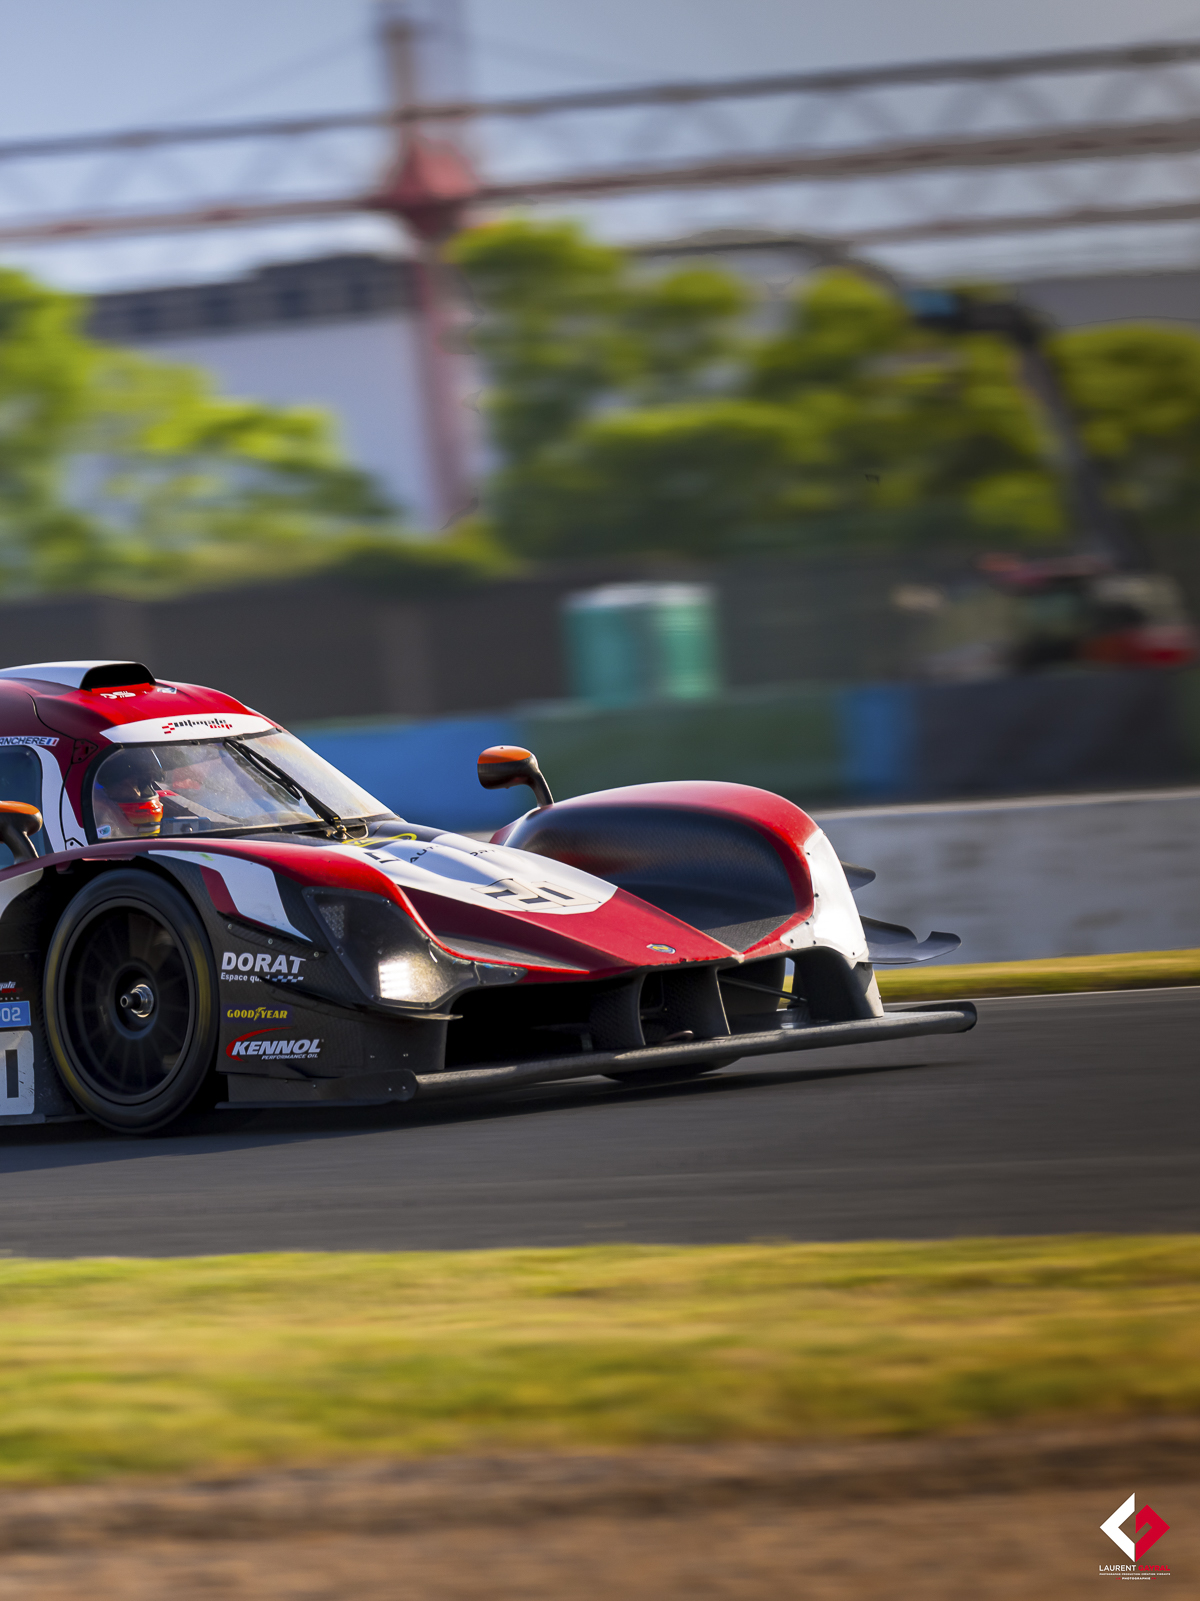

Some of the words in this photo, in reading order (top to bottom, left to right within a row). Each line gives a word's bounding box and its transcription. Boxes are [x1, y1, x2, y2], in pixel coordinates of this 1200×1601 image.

[221, 952, 306, 974] DORAT
[220, 972, 248, 982] Espace
[231, 1039, 321, 1056] KENNOL
